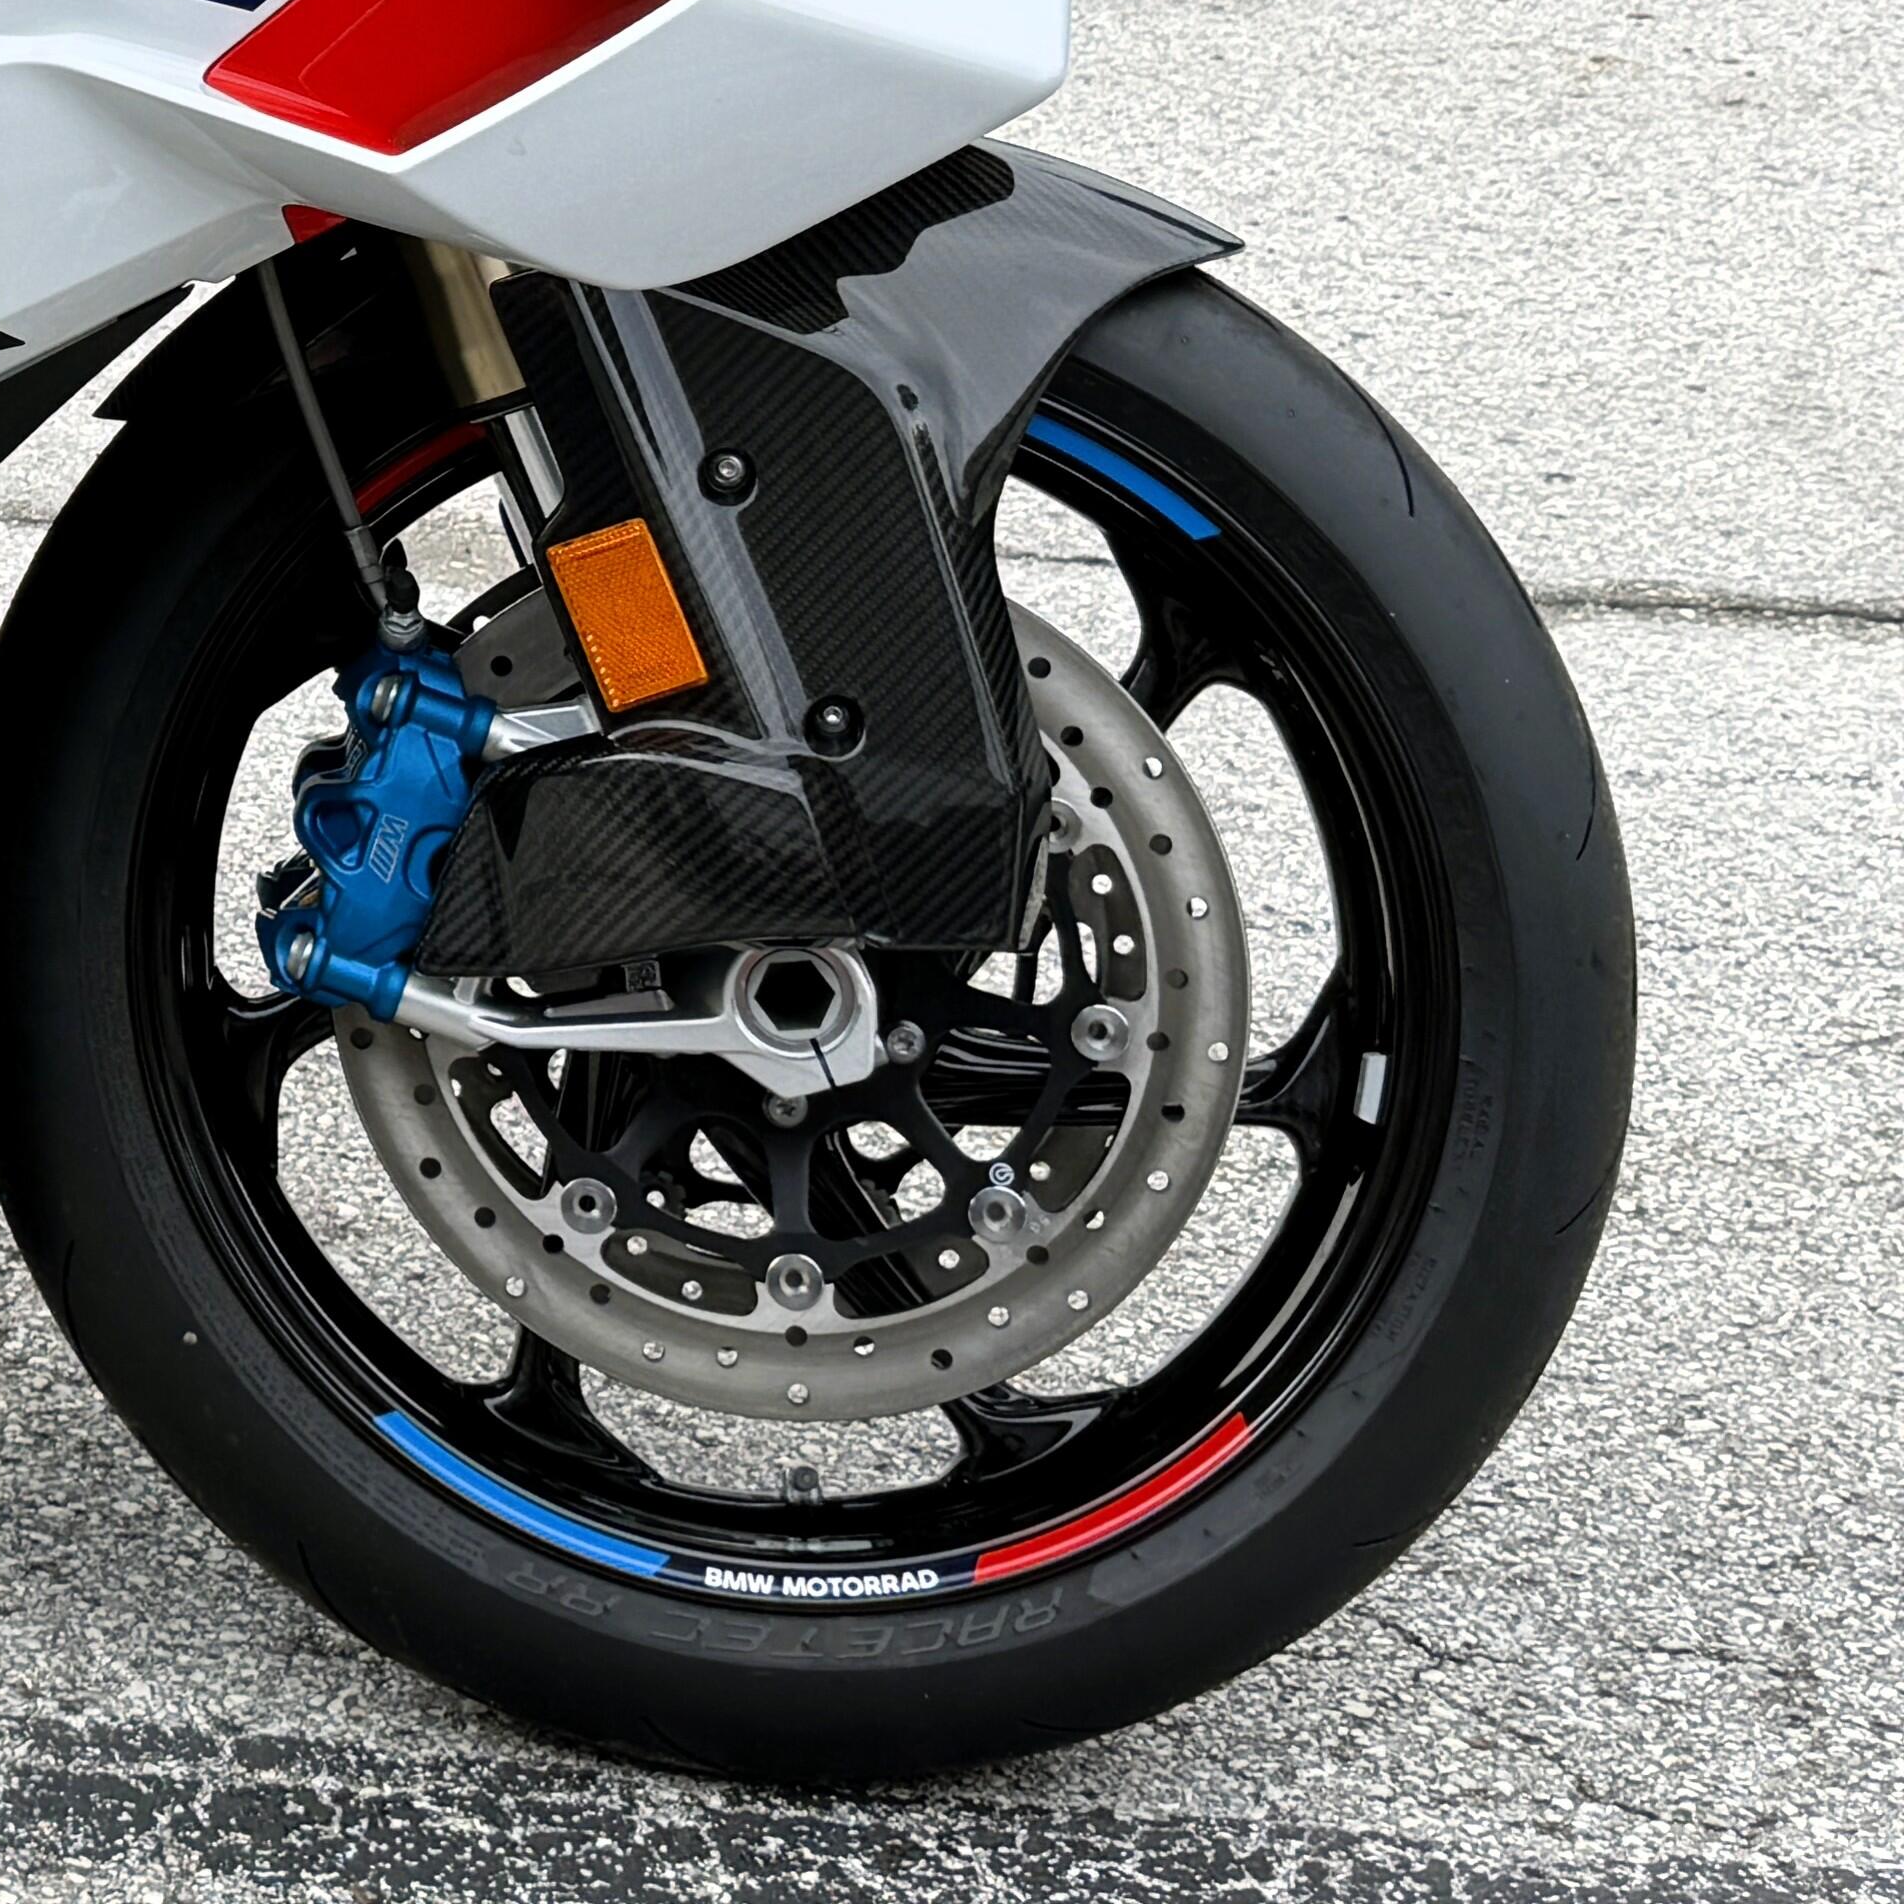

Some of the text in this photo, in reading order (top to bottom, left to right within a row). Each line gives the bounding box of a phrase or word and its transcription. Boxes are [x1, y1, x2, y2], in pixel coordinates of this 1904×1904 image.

[505, 1558, 1063, 1659] RACETEC RR
[703, 1565, 940, 1599] BMW MOTORRAD
